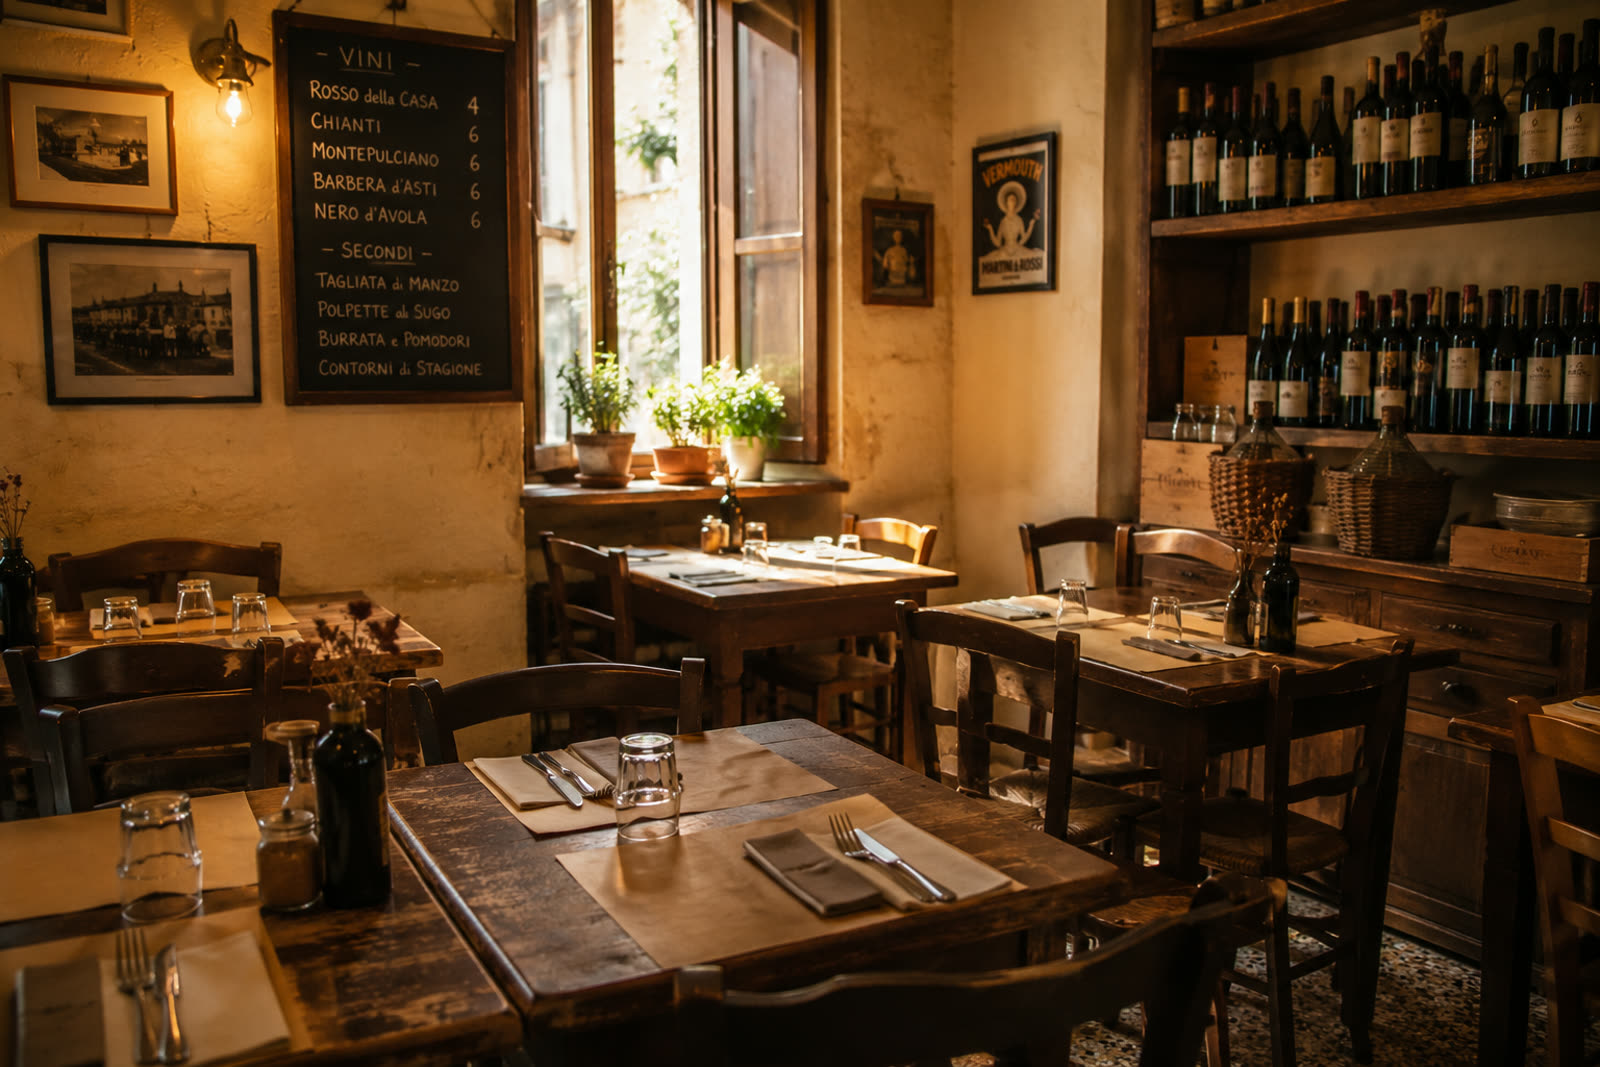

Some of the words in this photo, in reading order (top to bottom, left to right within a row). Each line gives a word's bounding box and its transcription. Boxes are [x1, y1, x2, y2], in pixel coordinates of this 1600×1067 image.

[339, 46, 392, 69] VINI
[309, 79, 359, 102] ROSSO
[363, 87, 396, 106] della
[399, 90, 439, 110] CASA
[467, 96, 480, 116] 4
[310, 111, 381, 134] CHIANTI
[468, 125, 479, 143] 6
[312, 141, 439, 167] MONTEPULCIANO
[469, 153, 480, 172] 6
[982, 158, 1043, 188] VERMOUTH
[312, 171, 386, 193] BARBERA
[391, 178, 437, 197] d'ASTI
[470, 182, 481, 201] 6
[314, 202, 359, 221] NERO
[364, 206, 428, 225] d'AVOLA
[470, 210, 481, 229] 6
[341, 241, 413, 261] SECONDI
[314, 271, 387, 290] TAGLIATA
[409, 276, 460, 293] MANZO
[317, 300, 389, 319] POLPETTE
[413, 303, 451, 320] SUGO
[318, 329, 386, 347] BURRATA
[403, 331, 470, 348] POMODORI
[318, 359, 393, 376] CONTORNI
[416, 359, 483, 377] STAGIONE
